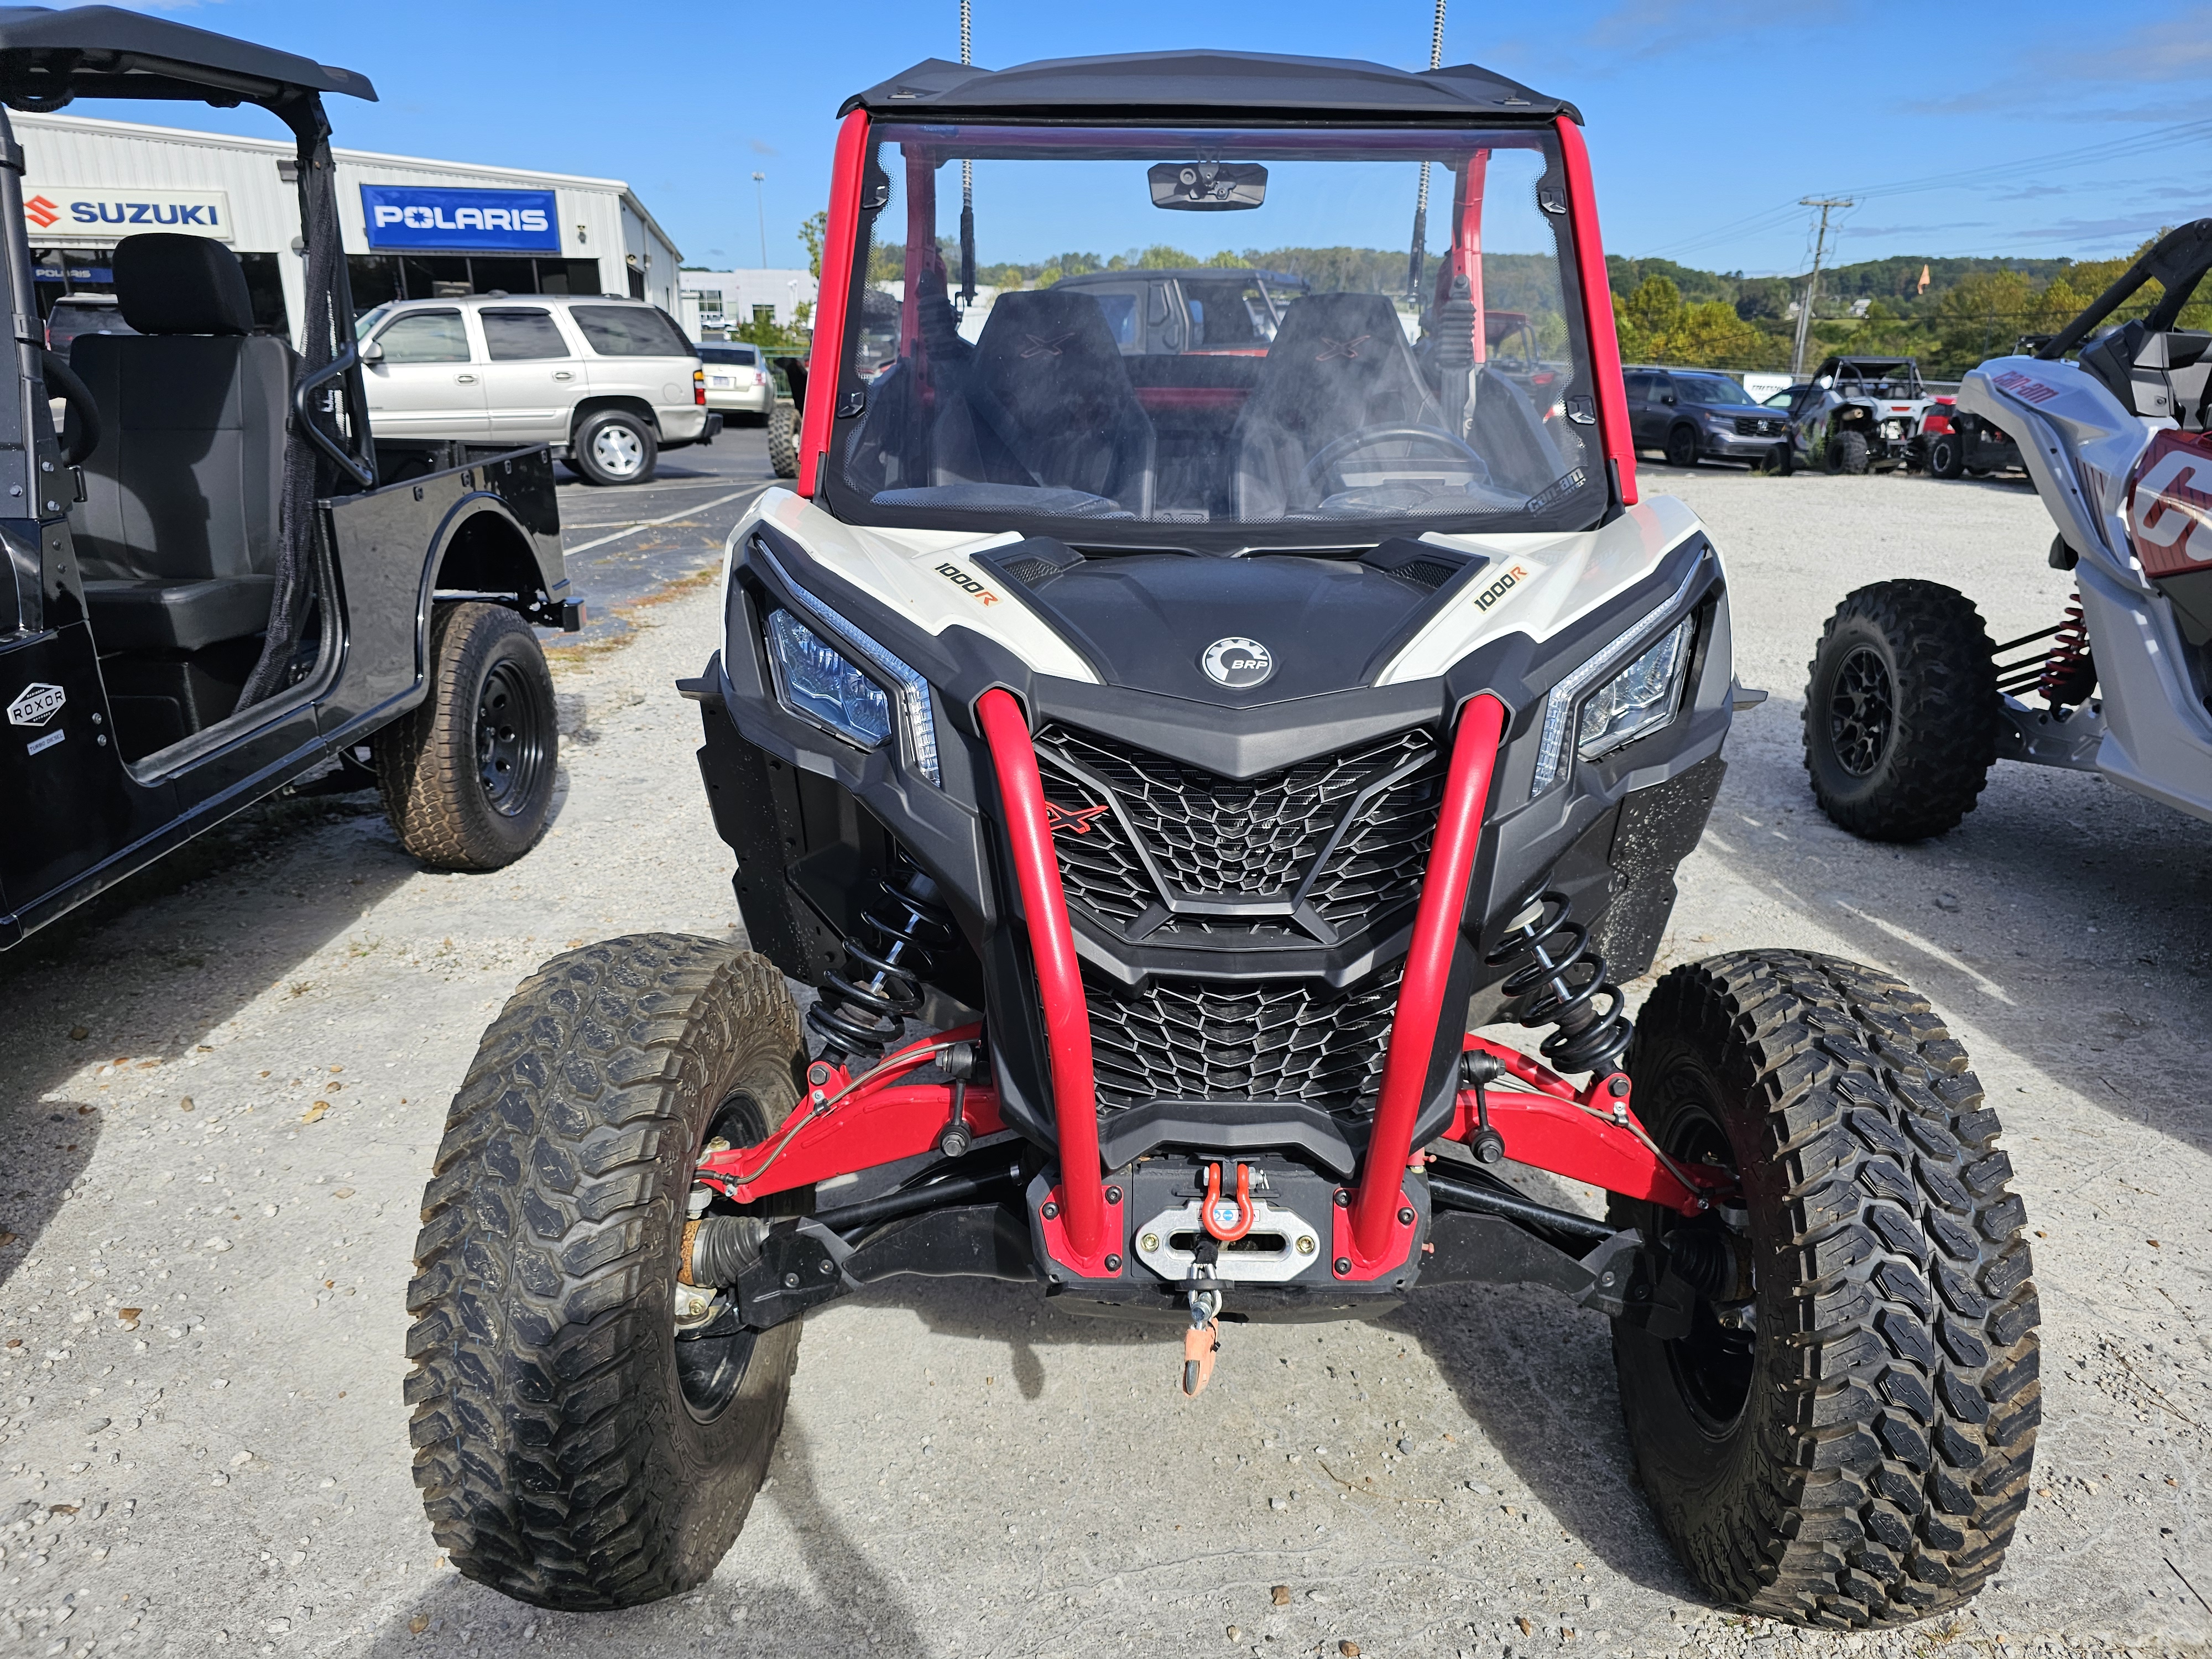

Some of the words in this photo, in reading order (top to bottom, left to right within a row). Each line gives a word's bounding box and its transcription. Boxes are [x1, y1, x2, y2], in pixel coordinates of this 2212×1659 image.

[70, 202, 218, 225] SUZUKI
[374, 205, 549, 232] POLARIS
[934, 562, 998, 607] 1000R
[1474, 566, 1527, 612] 1000R
[1231, 660, 1268, 670] BRP
[13, 691, 63, 721] ROXOR
[29, 740, 45, 752] TURBO
